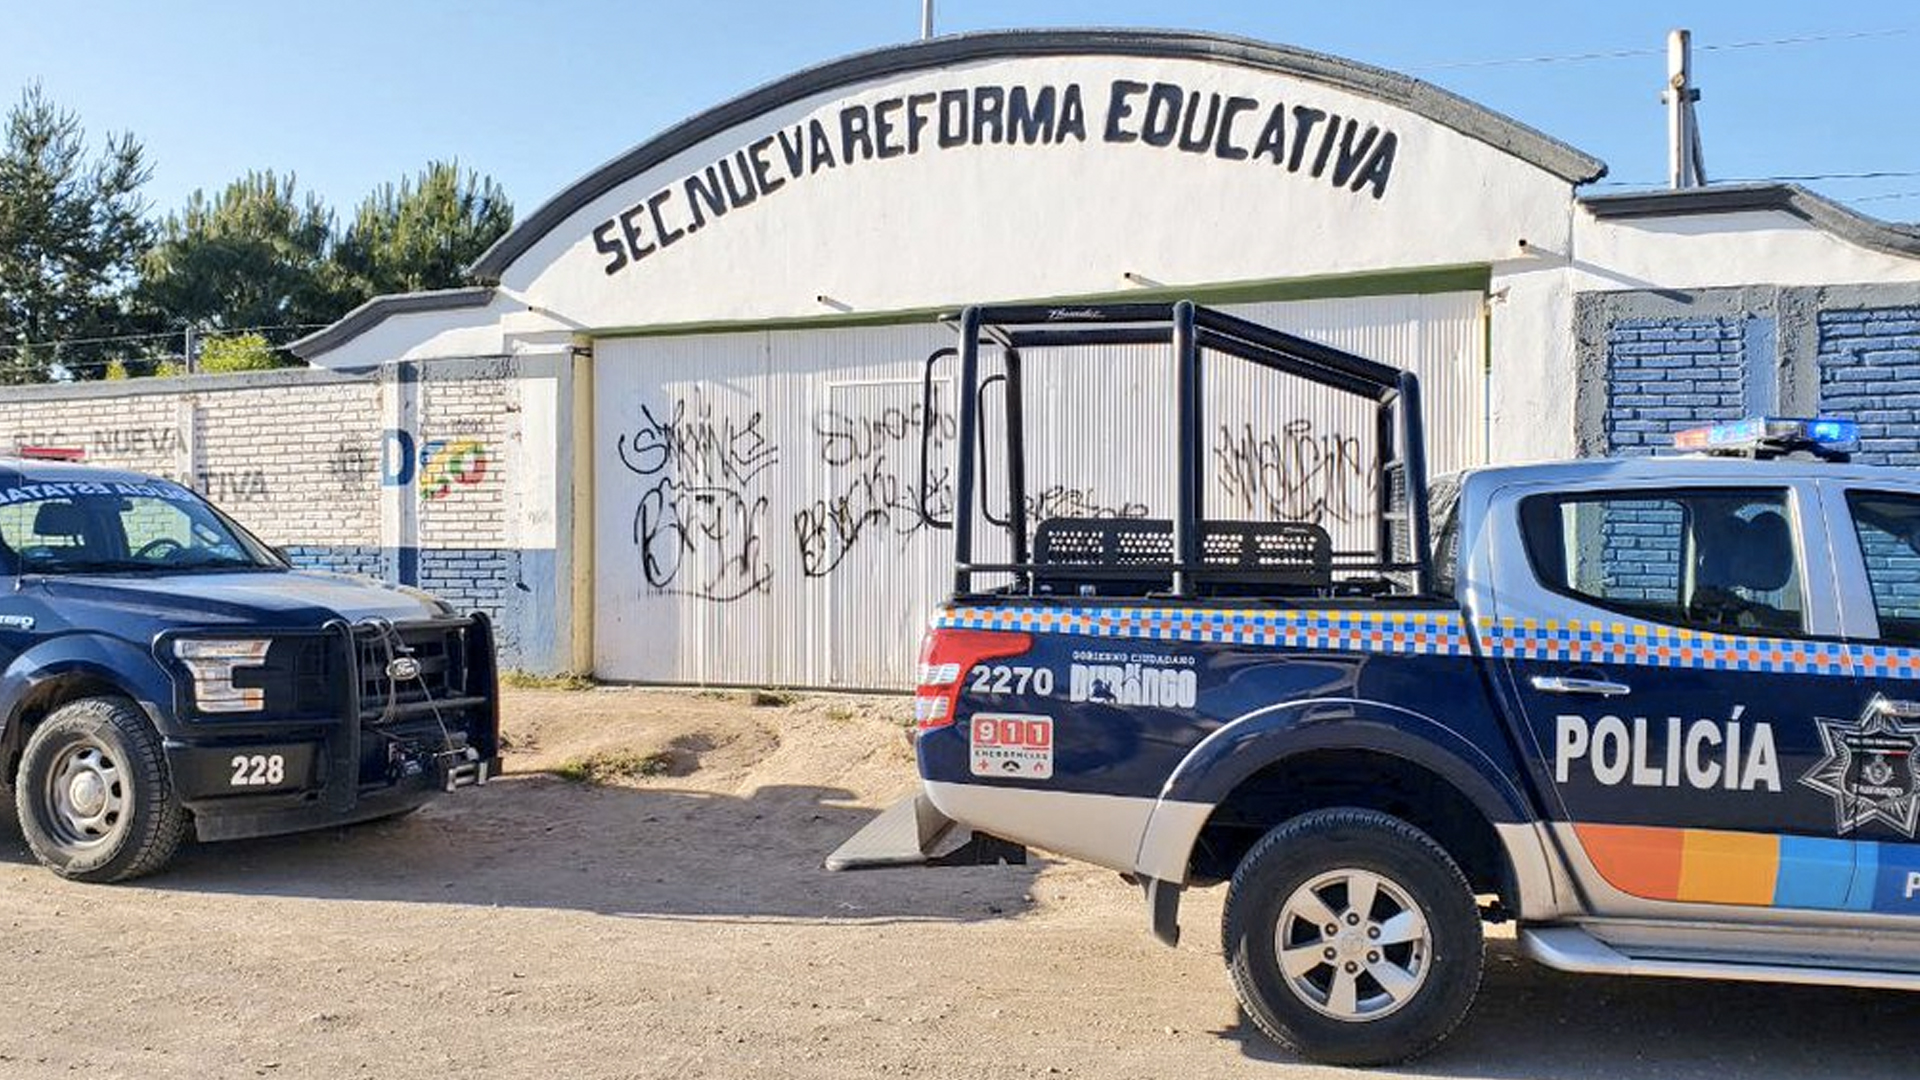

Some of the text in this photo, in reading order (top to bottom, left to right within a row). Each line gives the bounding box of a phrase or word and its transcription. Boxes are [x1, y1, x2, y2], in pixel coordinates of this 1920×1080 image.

[683, 118, 836, 228] NUEVA
[839, 84, 1086, 165] REFORMA
[1103, 79, 1399, 199] EDUCATIVA
[93, 427, 189, 454] NUEVA
[1071, 650, 1196, 665] GOBIERNO CIUDADANO
[970, 666, 1054, 696] 2270
[1069, 662, 1198, 708] DURANGO
[978, 721, 1044, 744] 911
[1555, 704, 1782, 792] POLICÍA
[230, 755, 285, 785] 228
